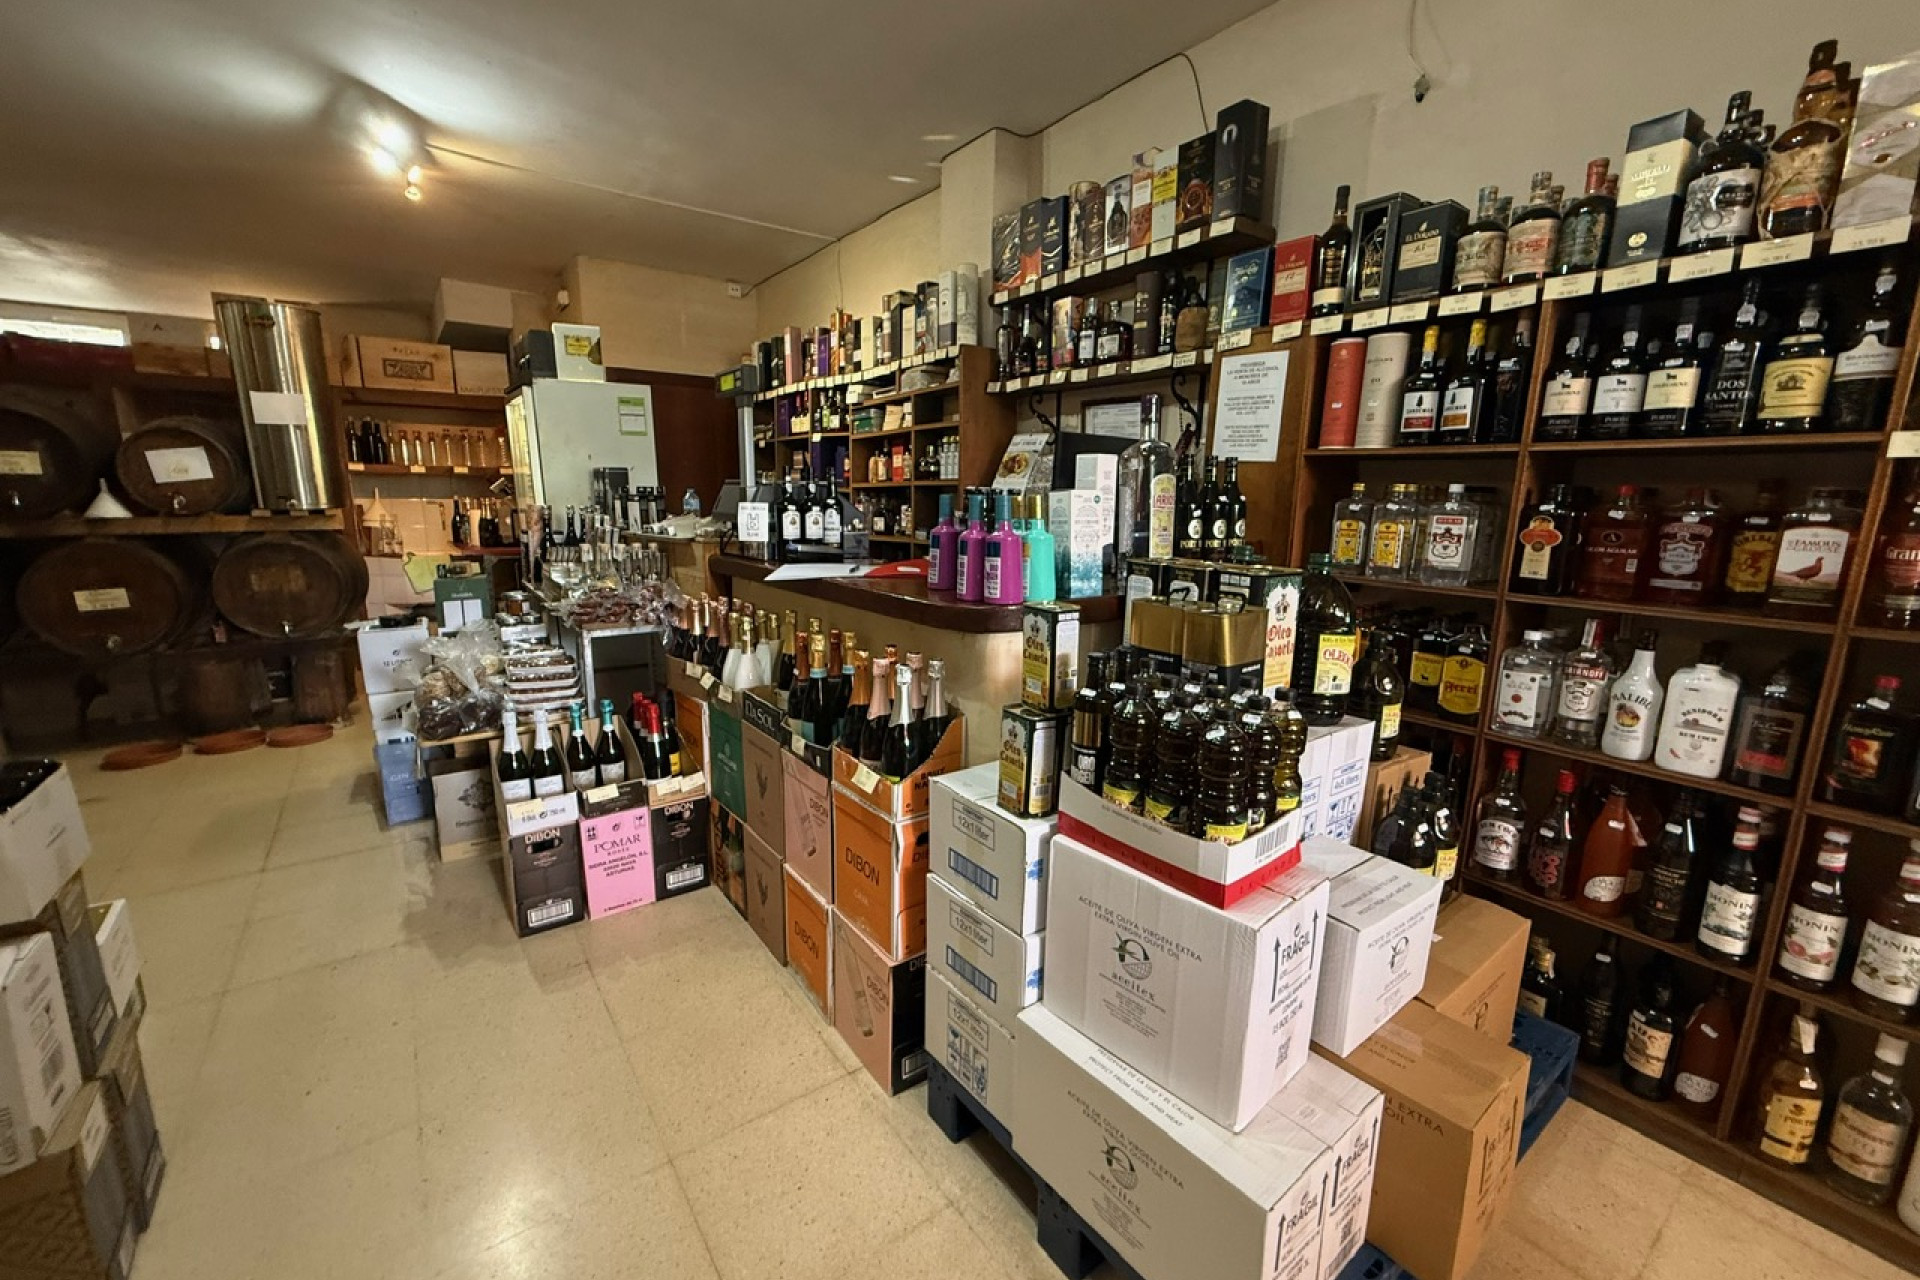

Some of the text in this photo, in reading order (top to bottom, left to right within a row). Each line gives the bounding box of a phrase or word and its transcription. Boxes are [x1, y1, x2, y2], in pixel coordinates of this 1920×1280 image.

[593, 833, 642, 854] POMAR
[845, 846, 880, 887] DIBON
[1078, 895, 1203, 963] ACEITE DE OLIVA VIRGEN EXTRA
[1094, 910, 1115, 927] EXTRA
[1792, 914, 1840, 934] MONIN
[794, 919, 820, 960] DIBON
[1281, 930, 1310, 967] FRAGIL
[1866, 931, 1920, 957] MONIN
[1385, 1106, 1405, 1126] OIL
[1398, 1101, 1444, 1138] EXTRA
[1158, 1161, 1184, 1191] EXTRA
